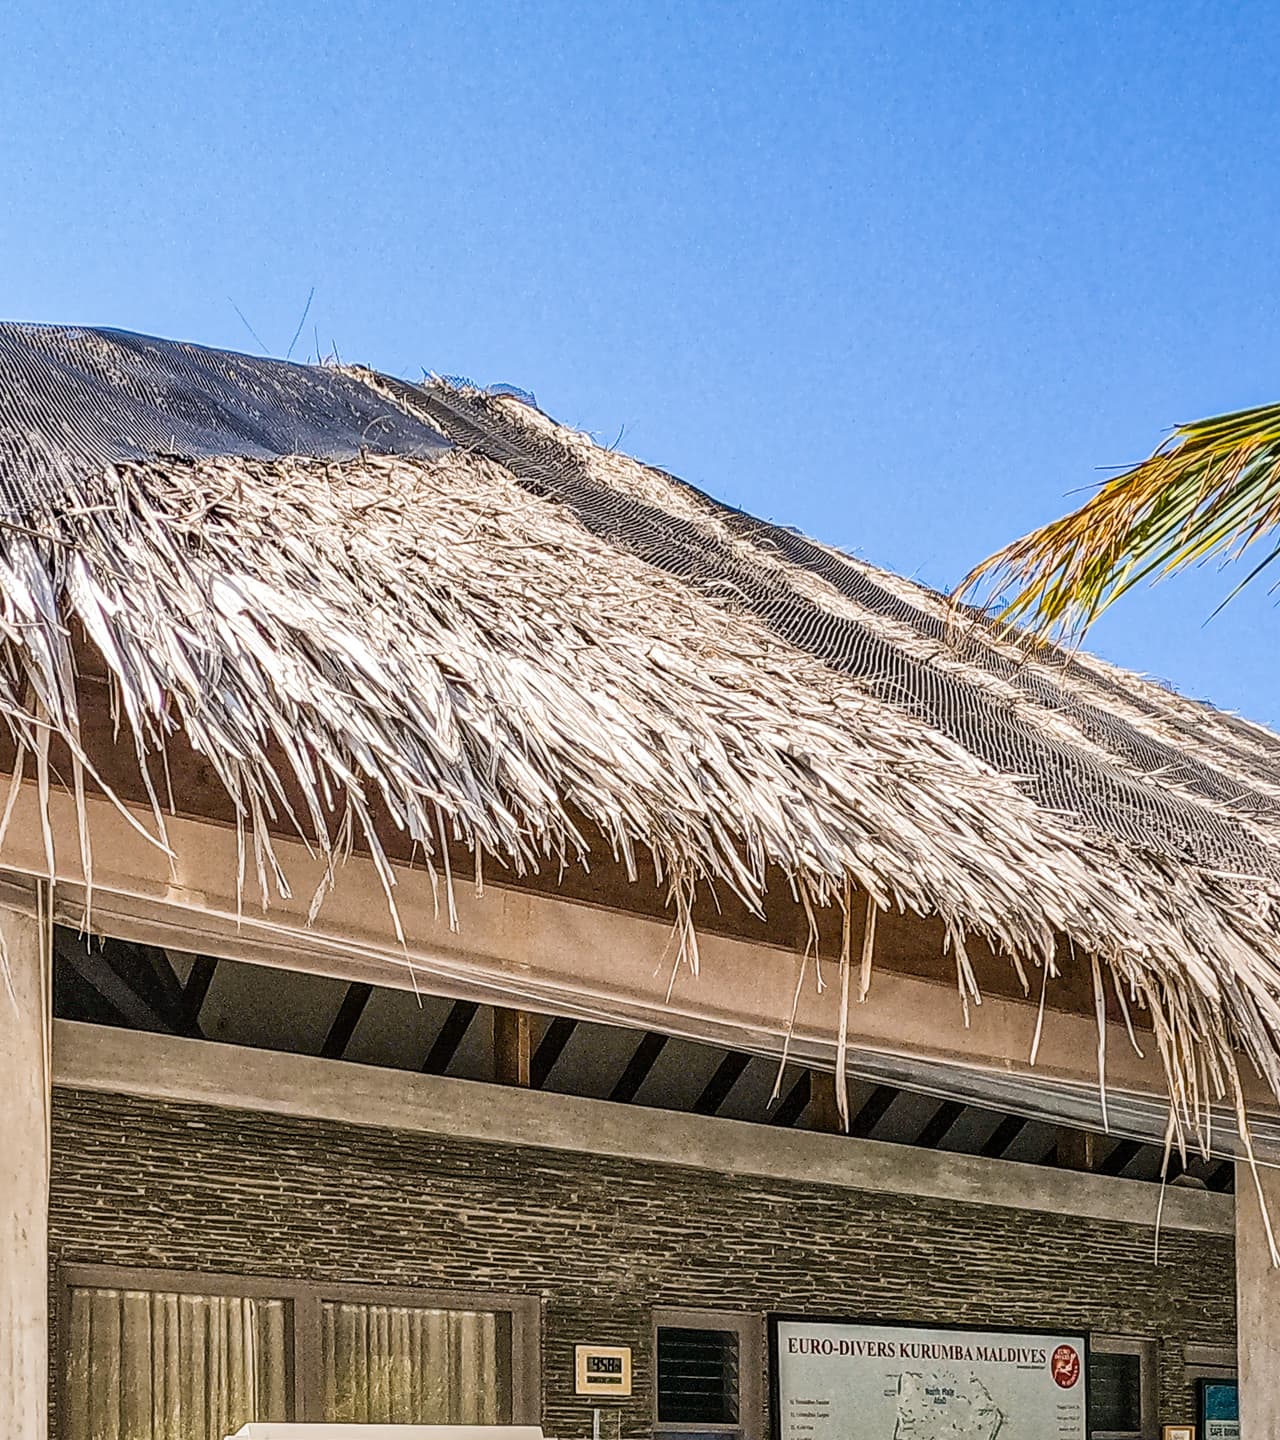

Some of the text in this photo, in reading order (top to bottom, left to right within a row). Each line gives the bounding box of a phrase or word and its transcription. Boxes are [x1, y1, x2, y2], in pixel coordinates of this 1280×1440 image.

[788, 1338, 1047, 1364] EURO-DIVERS KURUMBA MALDIVES
